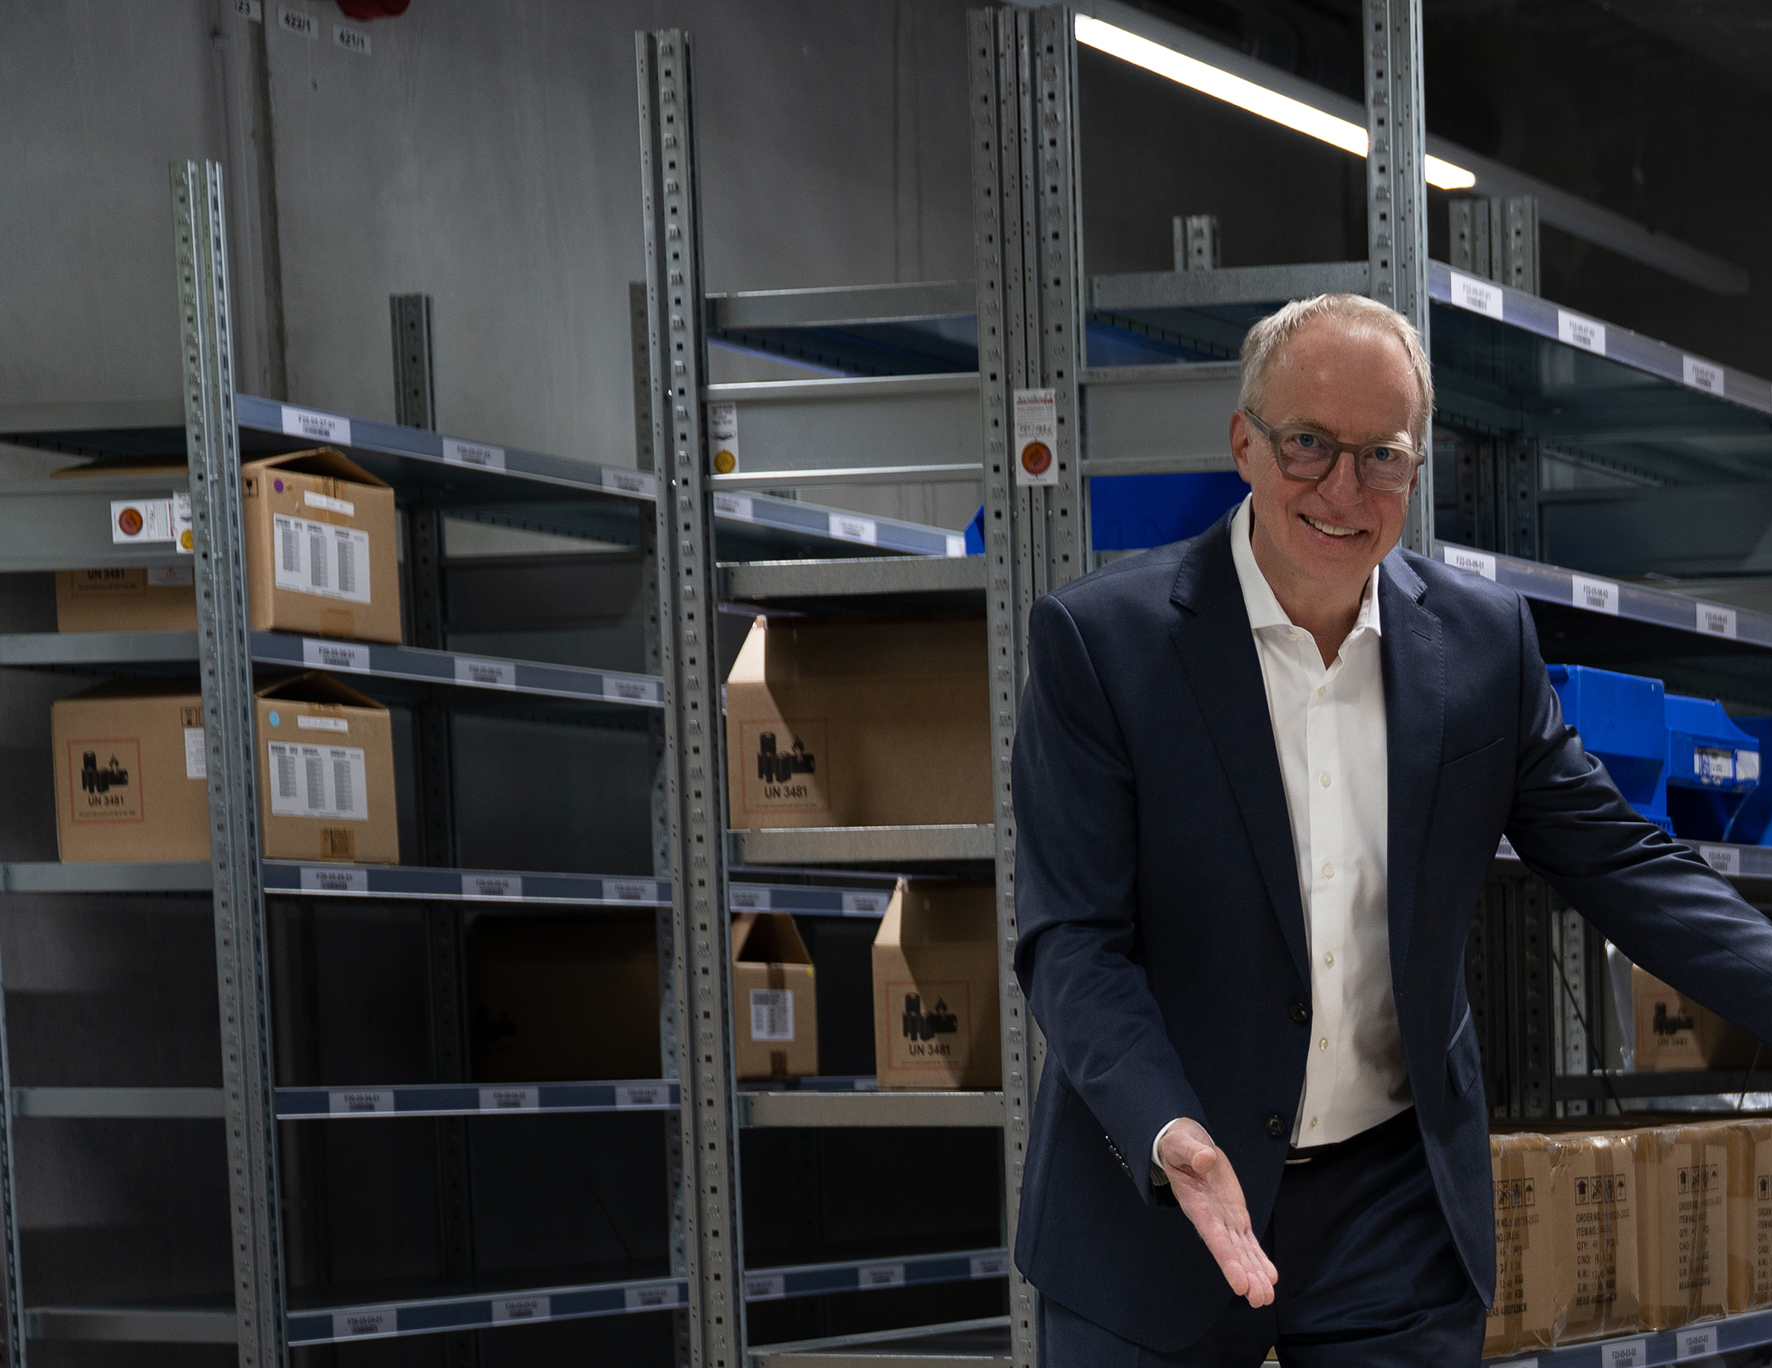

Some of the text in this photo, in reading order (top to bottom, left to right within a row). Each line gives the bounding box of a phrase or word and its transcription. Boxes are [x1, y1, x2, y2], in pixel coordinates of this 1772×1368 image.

[764, 784, 807, 798] UN 3481
[88, 795, 101, 806] UN
[908, 1043, 925, 1056] UN
